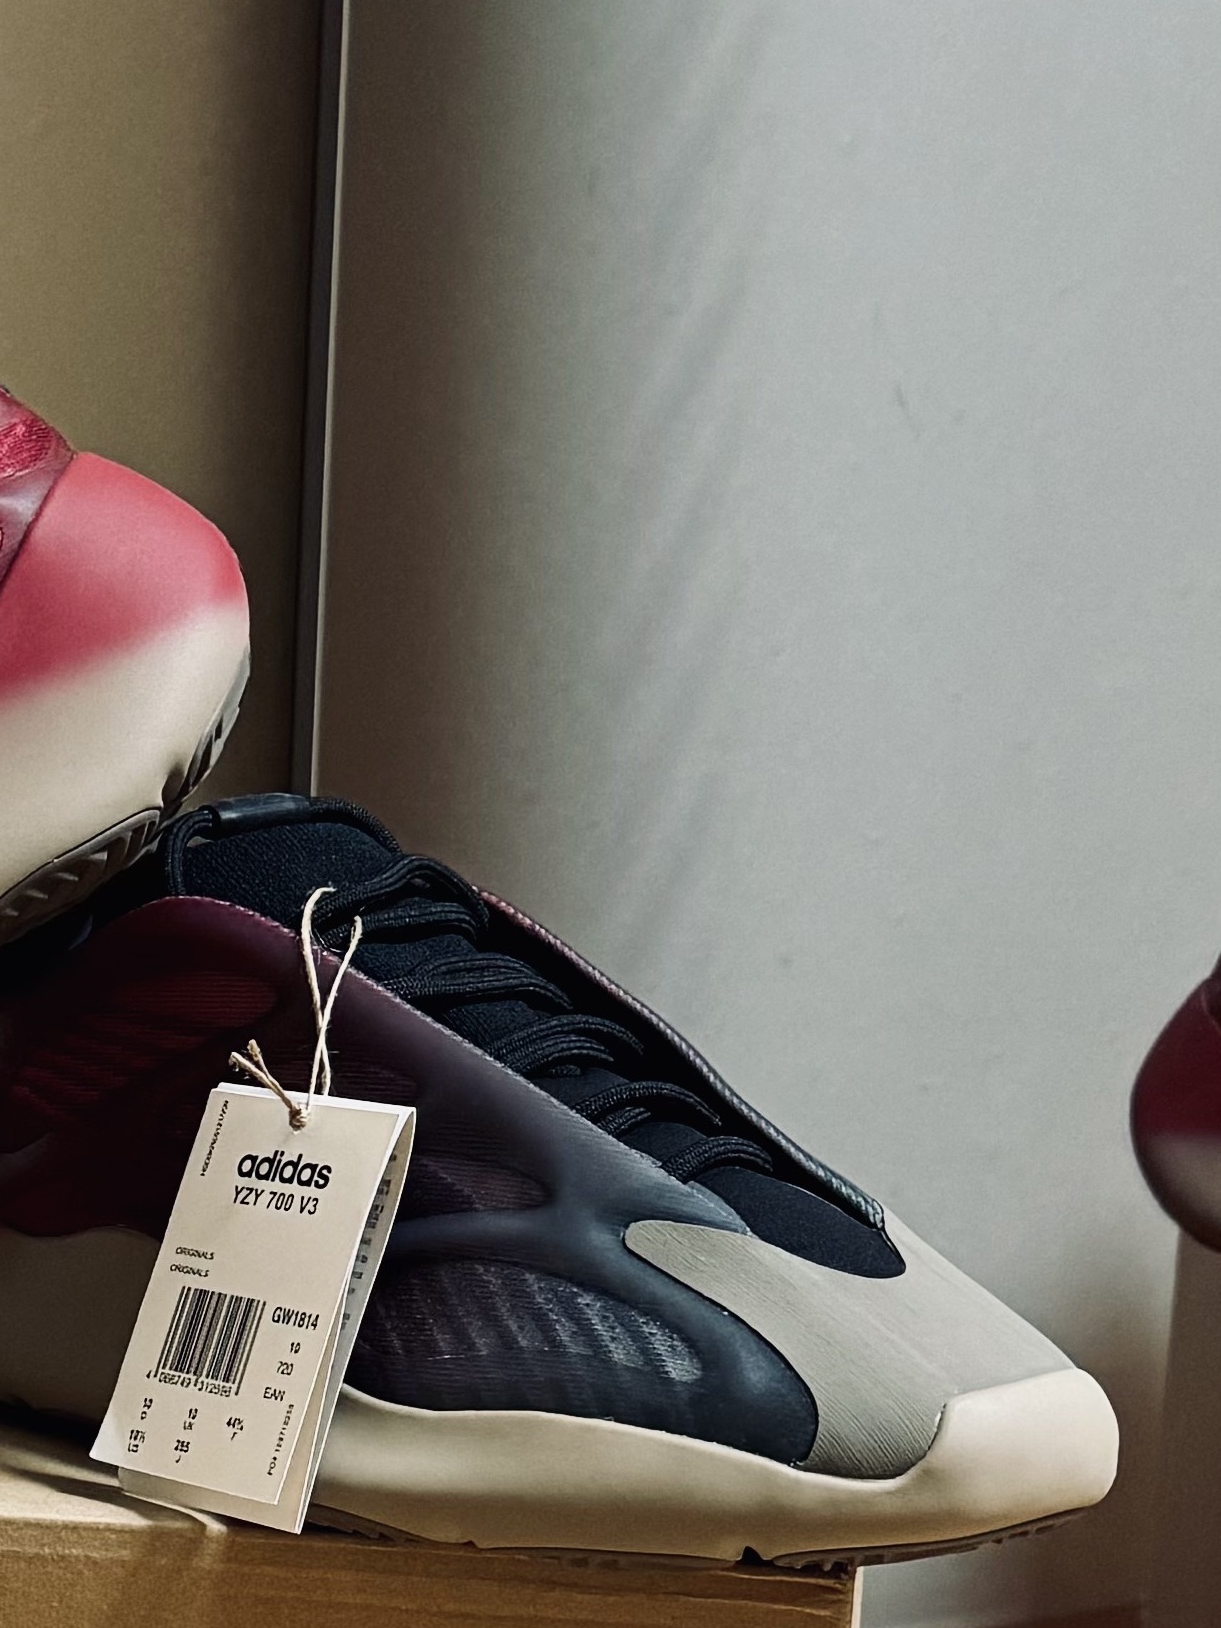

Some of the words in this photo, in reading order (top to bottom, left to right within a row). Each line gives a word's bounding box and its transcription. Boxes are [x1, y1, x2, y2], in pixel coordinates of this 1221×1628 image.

[236, 1149, 333, 1190] adidas
[233, 1185, 266, 1207] YZY
[266, 1190, 295, 1212] 700
[299, 1195, 320, 1215] V3
[271, 1306, 320, 1331] GW1814
